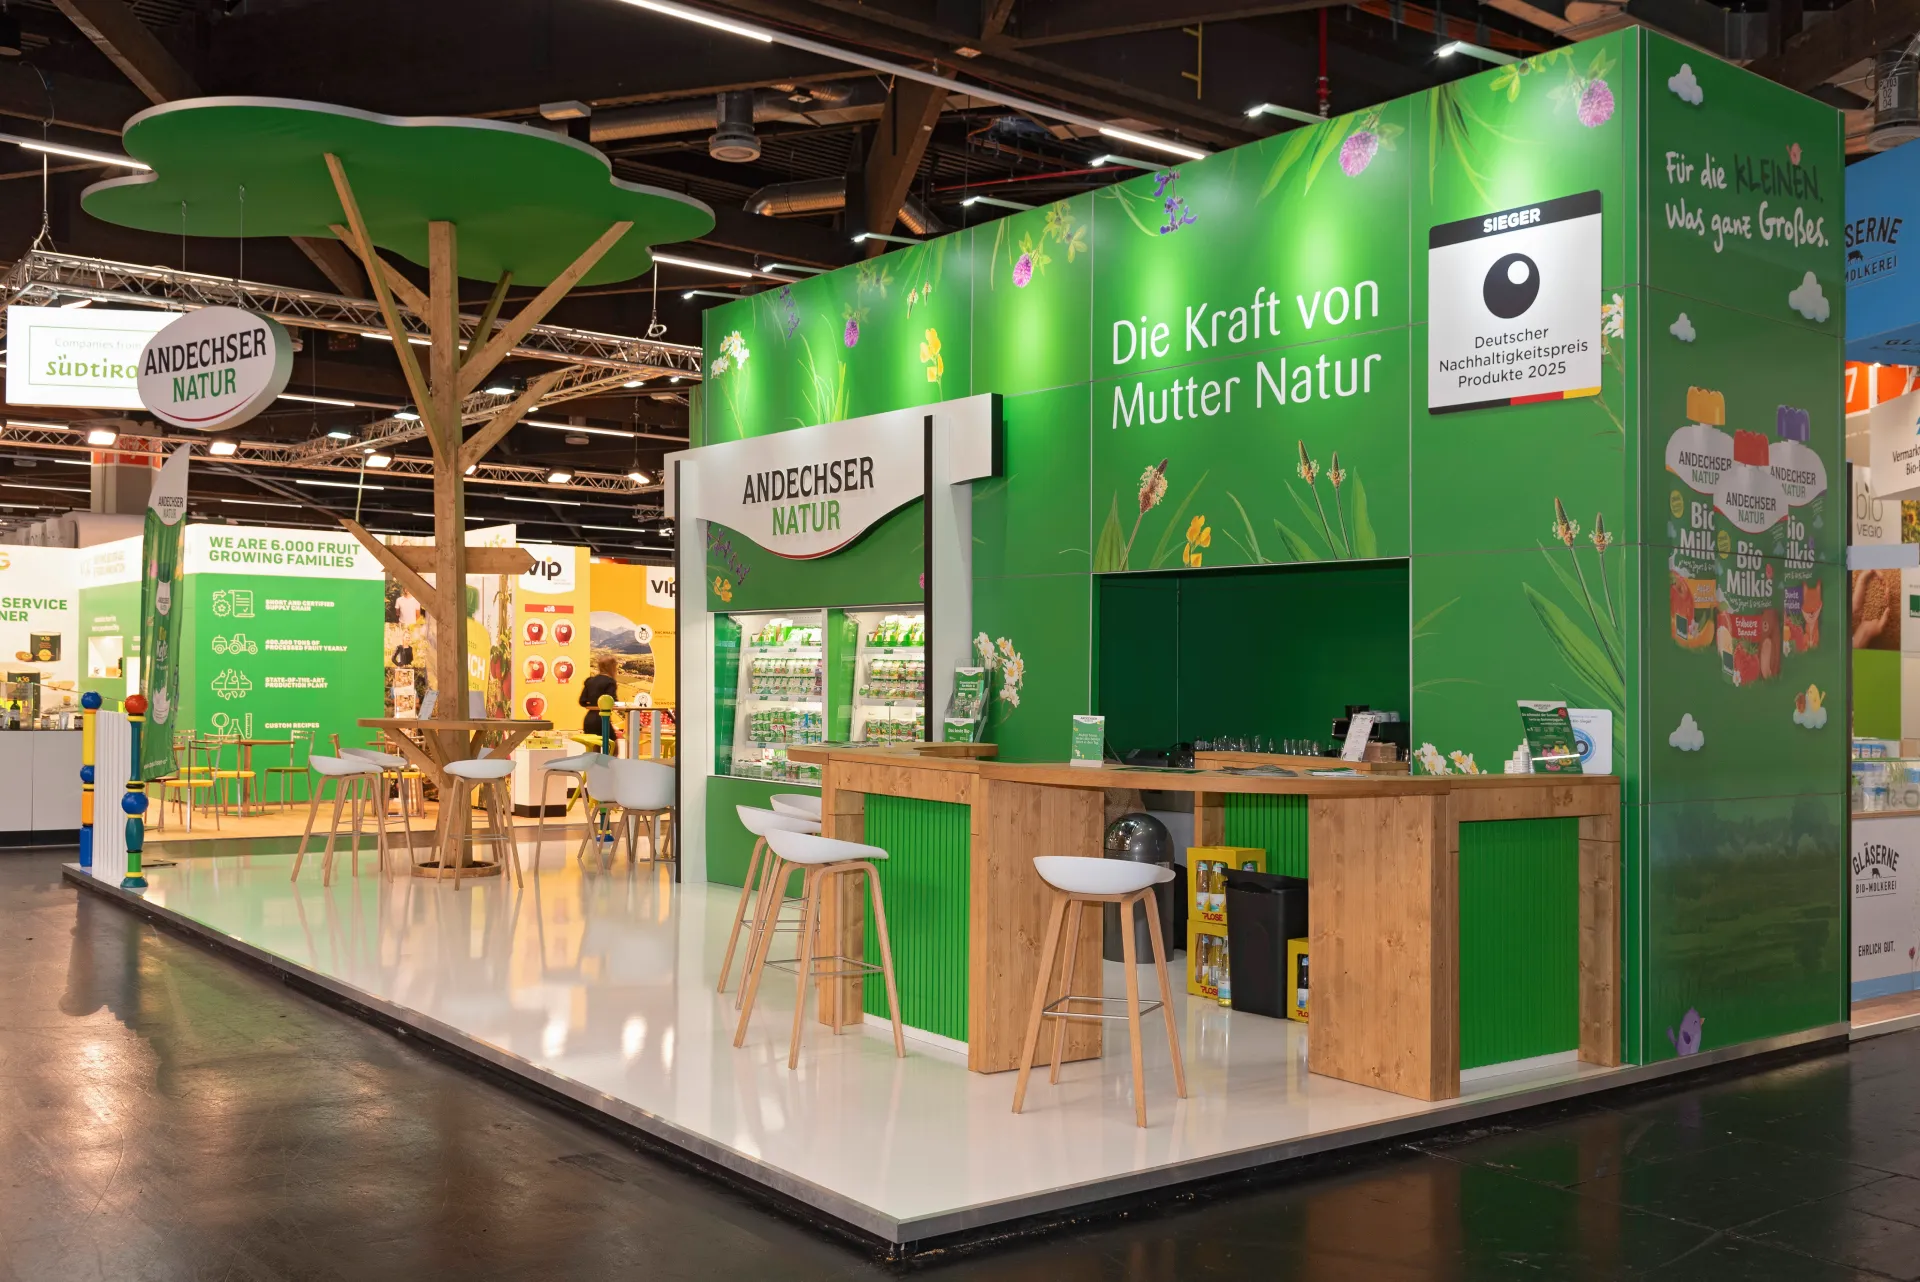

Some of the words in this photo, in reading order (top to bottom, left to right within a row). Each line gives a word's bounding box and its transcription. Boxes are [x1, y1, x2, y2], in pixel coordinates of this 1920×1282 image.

[1882, 98, 1892, 108] 04
[1883, 88, 1892, 99] 02
[1665, 150, 1694, 184] Für
[1700, 153, 1728, 190] die
[1483, 208, 1541, 234] SIEGER
[1665, 197, 1704, 237] Was
[1711, 213, 1752, 254] ganz
[1758, 200, 1829, 248] Großes.
[1112, 315, 1171, 366] Die
[1185, 286, 1281, 352] Kraft
[1296, 280, 1379, 330] von
[1474, 327, 1549, 350] Deutscher
[144, 328, 267, 376] ANDECHSER
[1439, 340, 1589, 373] Nachhaltigkeitspreis
[1457, 368, 1524, 388] Produkte
[1528, 360, 1567, 380] 2025
[172, 368, 236, 404] NATUR
[1112, 376, 1240, 430] Mutter
[1256, 353, 1382, 408] Natur
[1678, 451, 1732, 471] ANDECHSER
[742, 456, 875, 505] ANDECHSER
[1770, 466, 1816, 485] ANDECHSER
[158, 496, 184, 508] ANDECHSER
[1726, 492, 1776, 511] ANDECHSER
[1856, 482, 1883, 522] bio
[772, 499, 841, 536] NATUR
[1738, 510, 1765, 524] NATUR
[1856, 522, 1882, 539] VEGIO
[210, 536, 233, 548] WE
[237, 538, 267, 550] ARE
[271, 540, 314, 552] 6.000
[318, 542, 360, 555] FRUIT
[1737, 540, 1763, 570] Bio
[209, 550, 283, 564] GROWING
[287, 554, 354, 568] FAMILIES
[528, 556, 562, 580] vip
[1726, 568, 1773, 598] Milkis
[2, 597, 68, 610] SERVICE
[0, 610, 28, 622] NER
[1736, 617, 1758, 628] Erdbeere
[1738, 629, 1756, 637] Banane
[1852, 842, 1899, 876] GLÄSERNE
[1856, 880, 1897, 894] BIO-MOLKEREI
[1202, 912, 1223, 922] PLOSE
[1858, 942, 1882, 957] EHRLICH
[1884, 940, 1896, 955] GUT.
